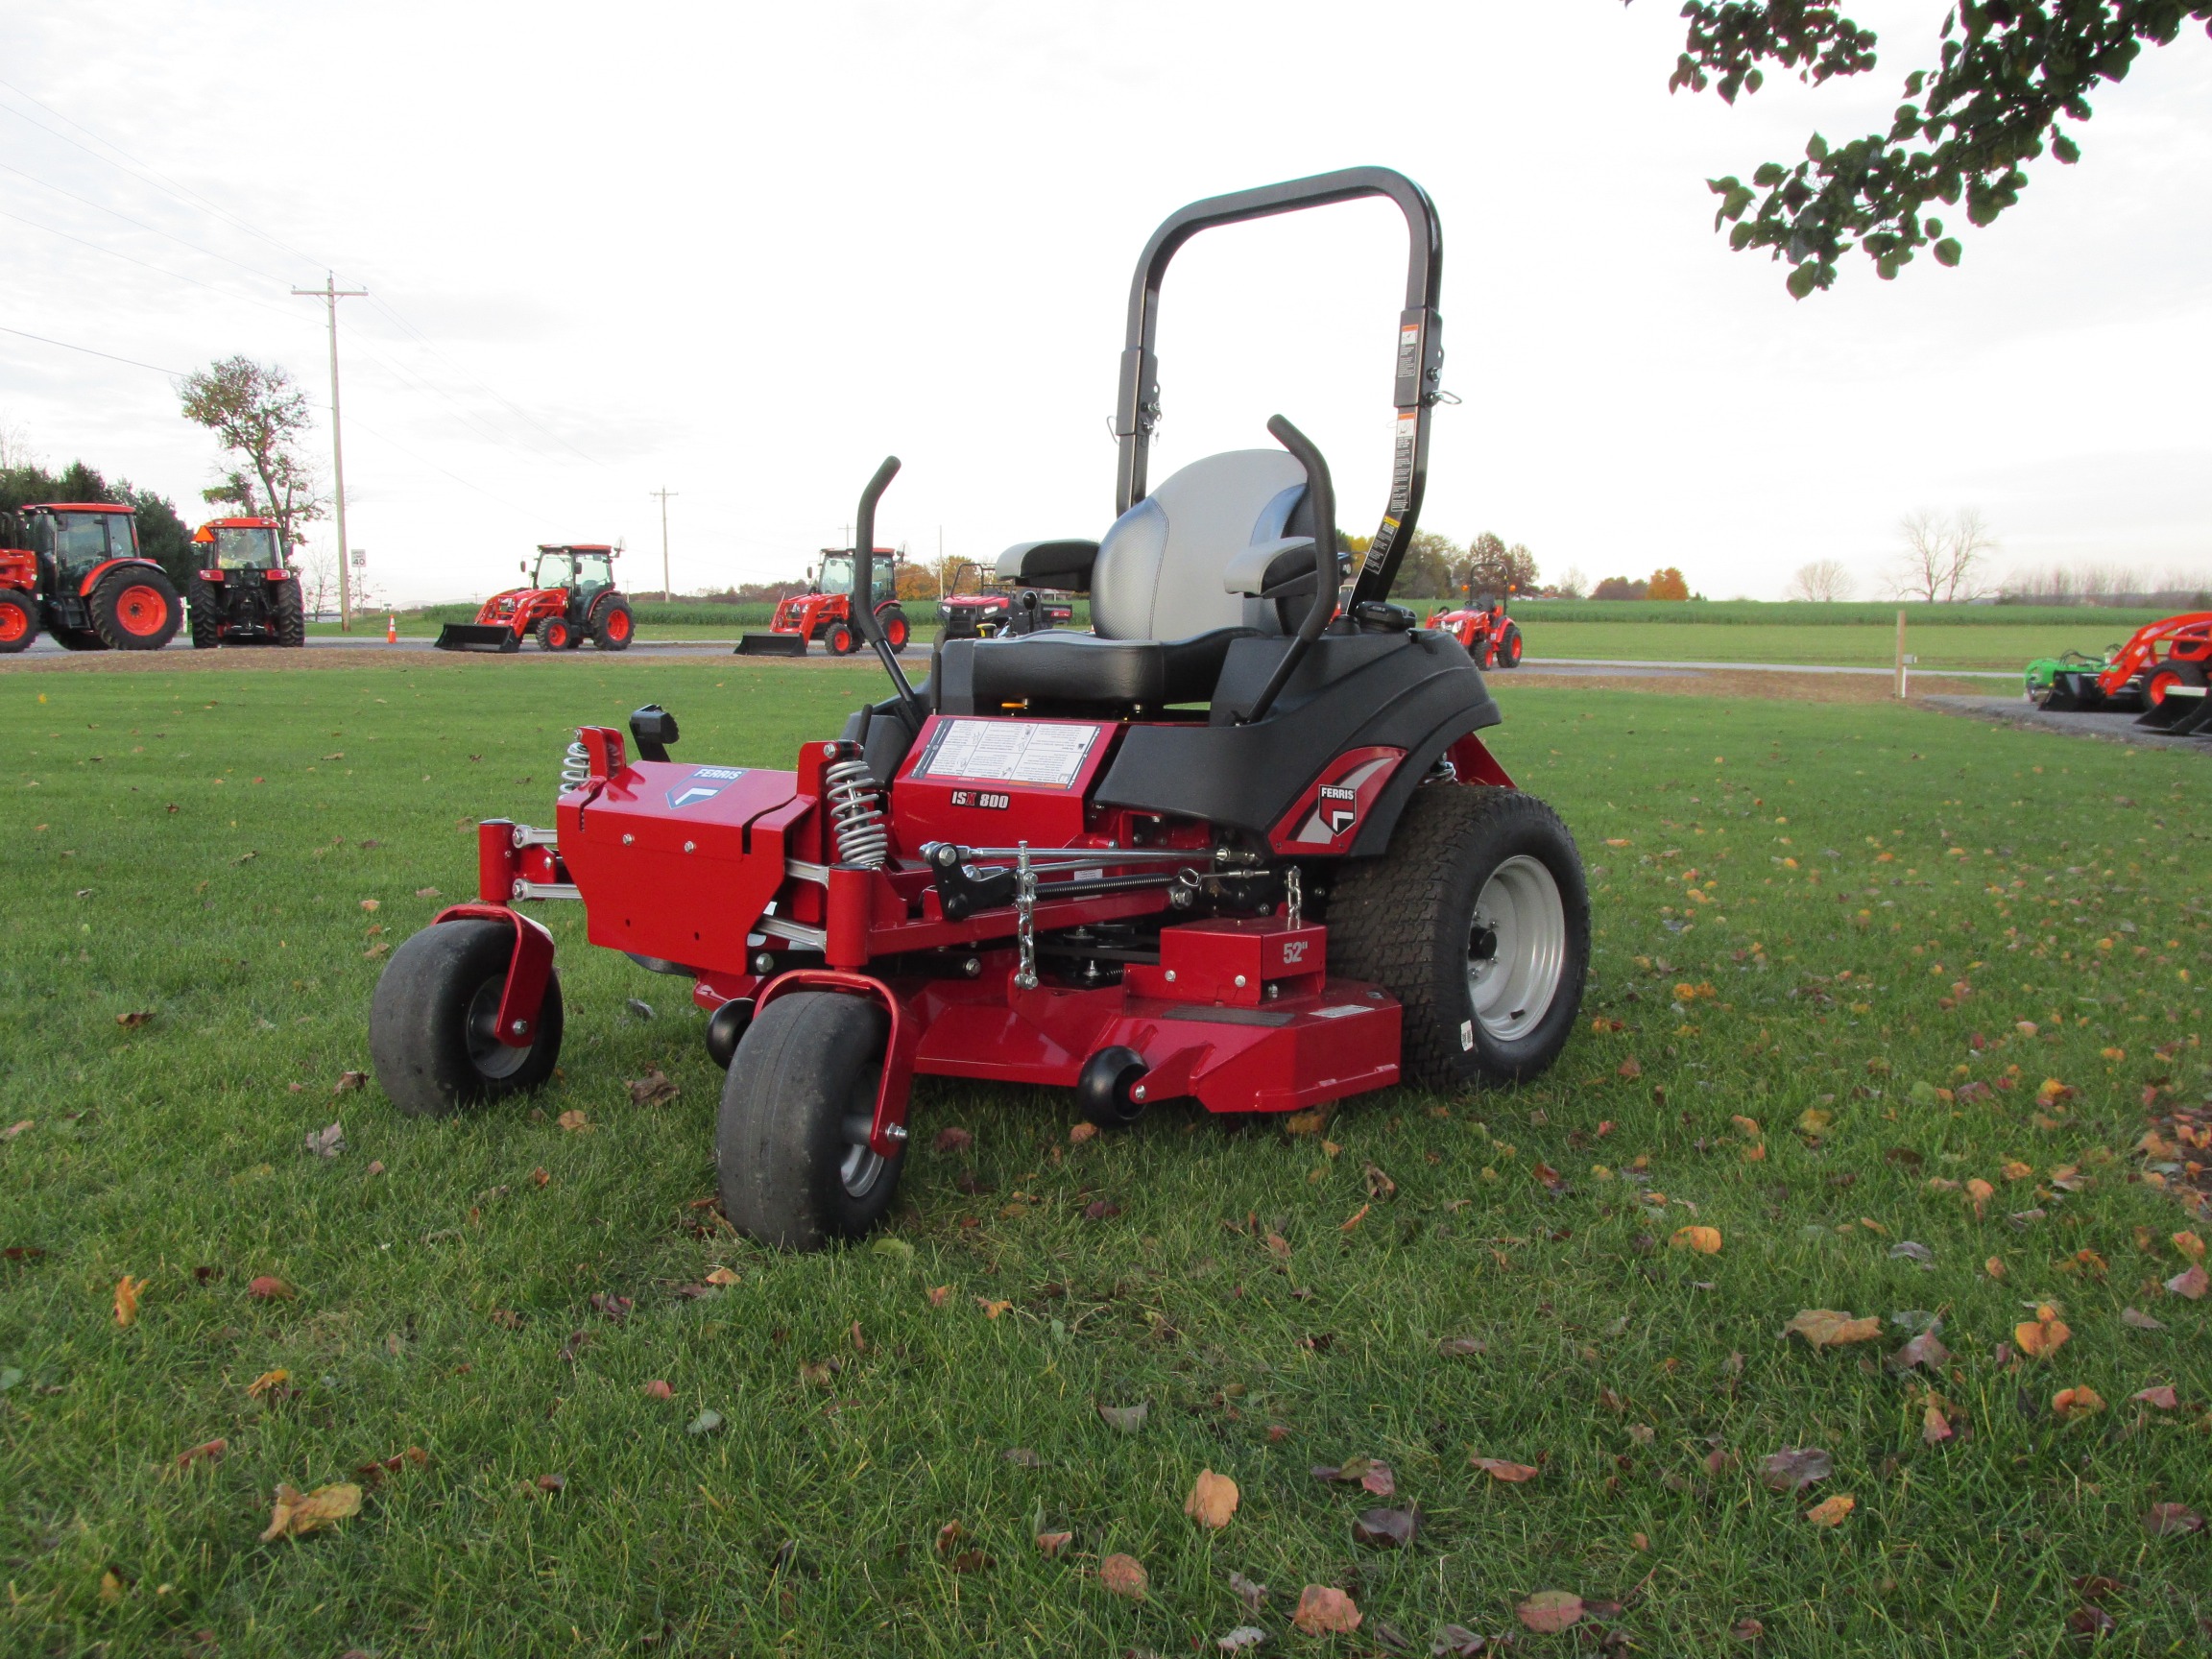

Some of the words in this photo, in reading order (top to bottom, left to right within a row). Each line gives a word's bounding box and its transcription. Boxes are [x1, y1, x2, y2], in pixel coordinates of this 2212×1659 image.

[693, 769, 742, 780] FERRIS
[951, 791, 976, 806] ISX
[979, 794, 1009, 809] 800
[1321, 786, 1355, 801] FERRIS
[1283, 941, 1309, 964] 52"
